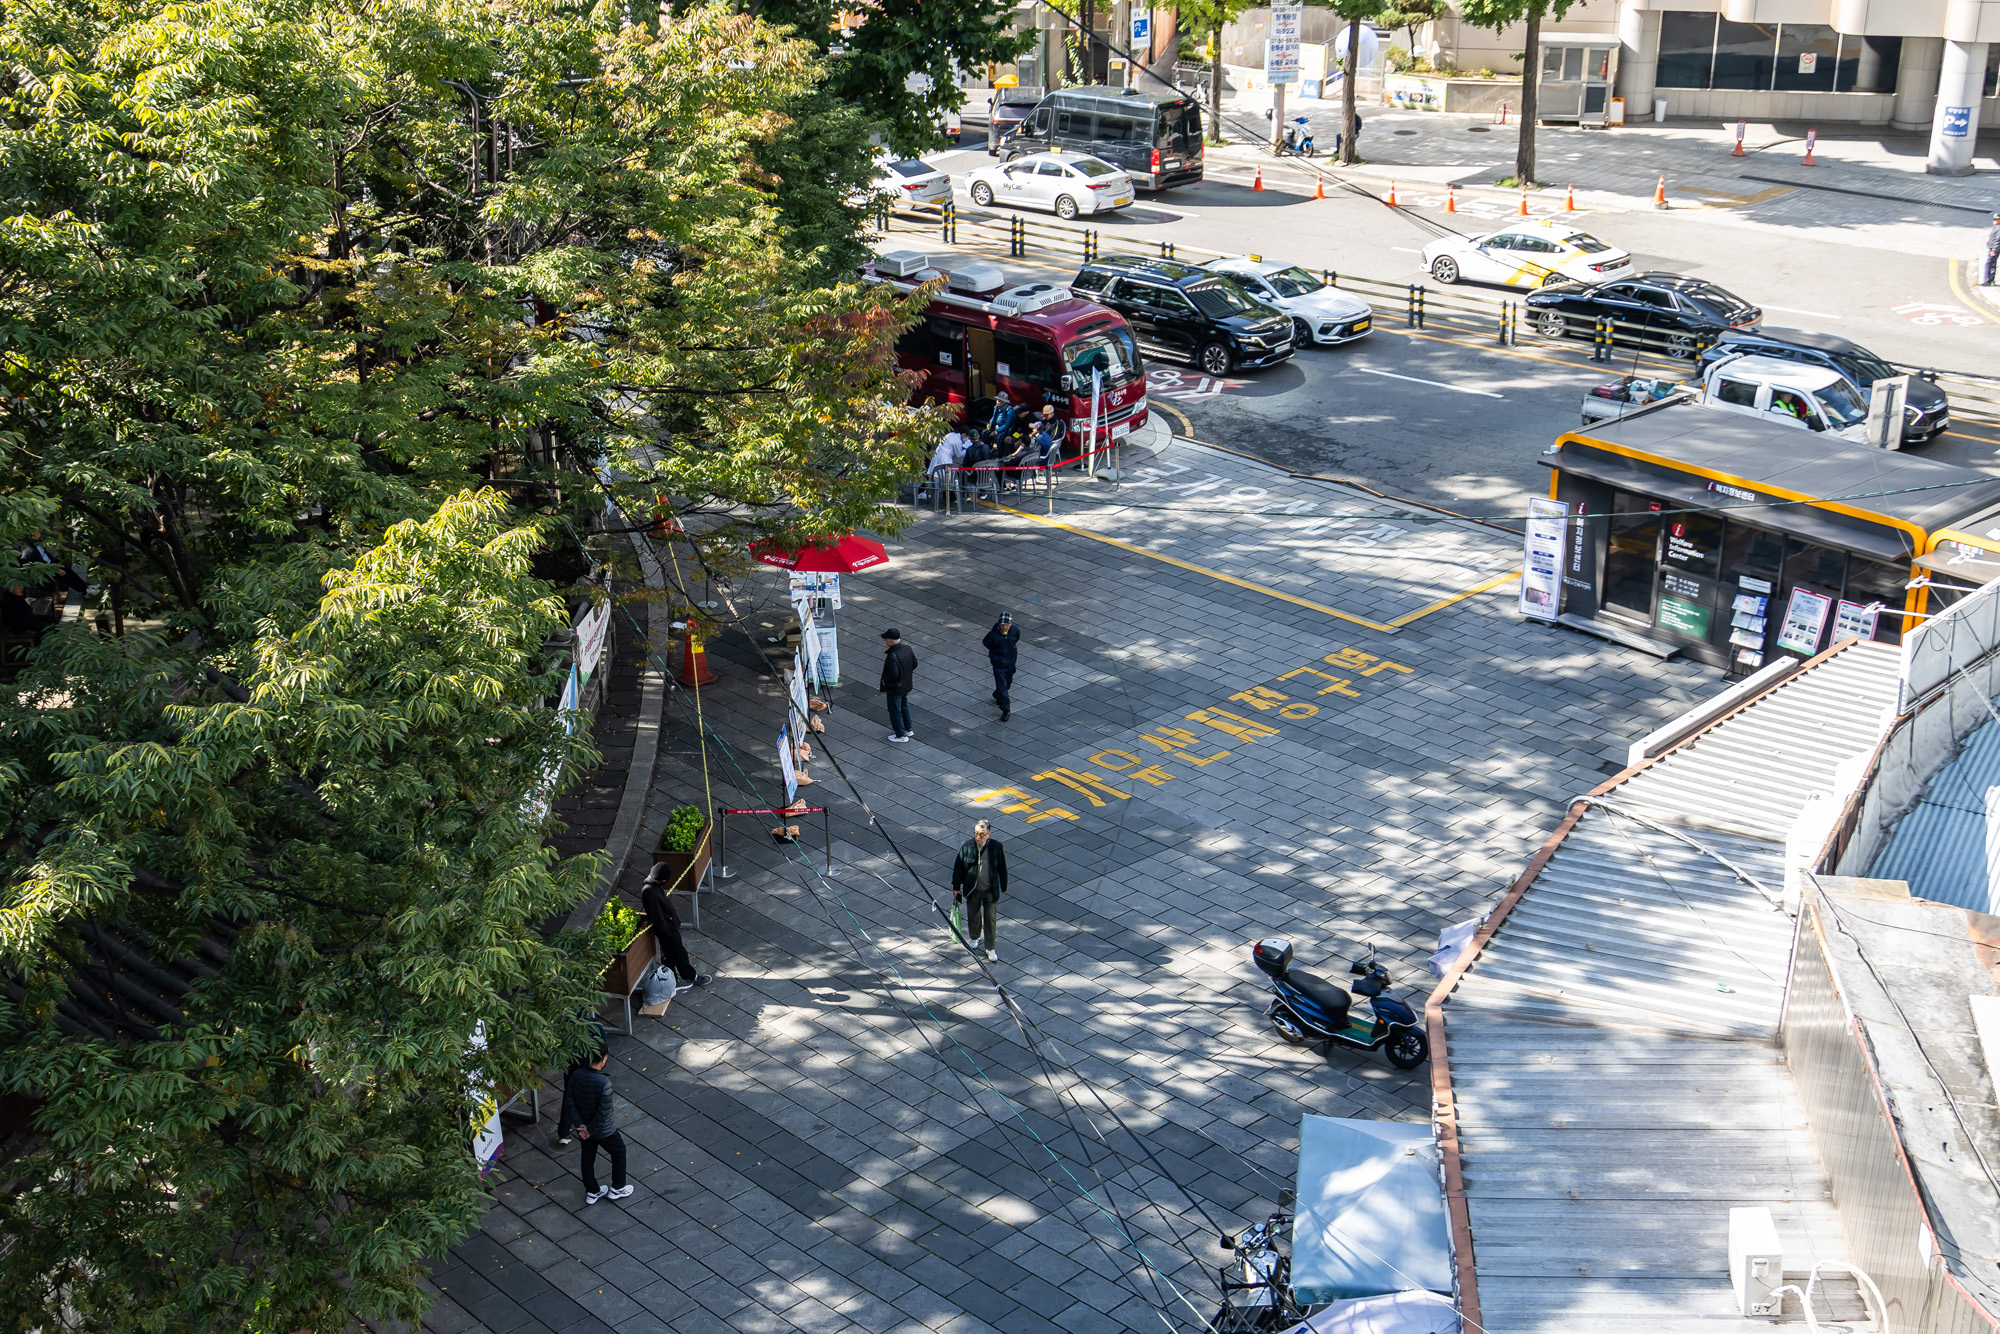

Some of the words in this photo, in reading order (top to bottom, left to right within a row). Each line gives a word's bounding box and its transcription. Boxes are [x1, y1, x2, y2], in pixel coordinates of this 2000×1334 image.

[1669, 536, 1694, 549] Welfare
[1668, 543, 1704, 559] Information
[1668, 550, 1689, 562] Center
